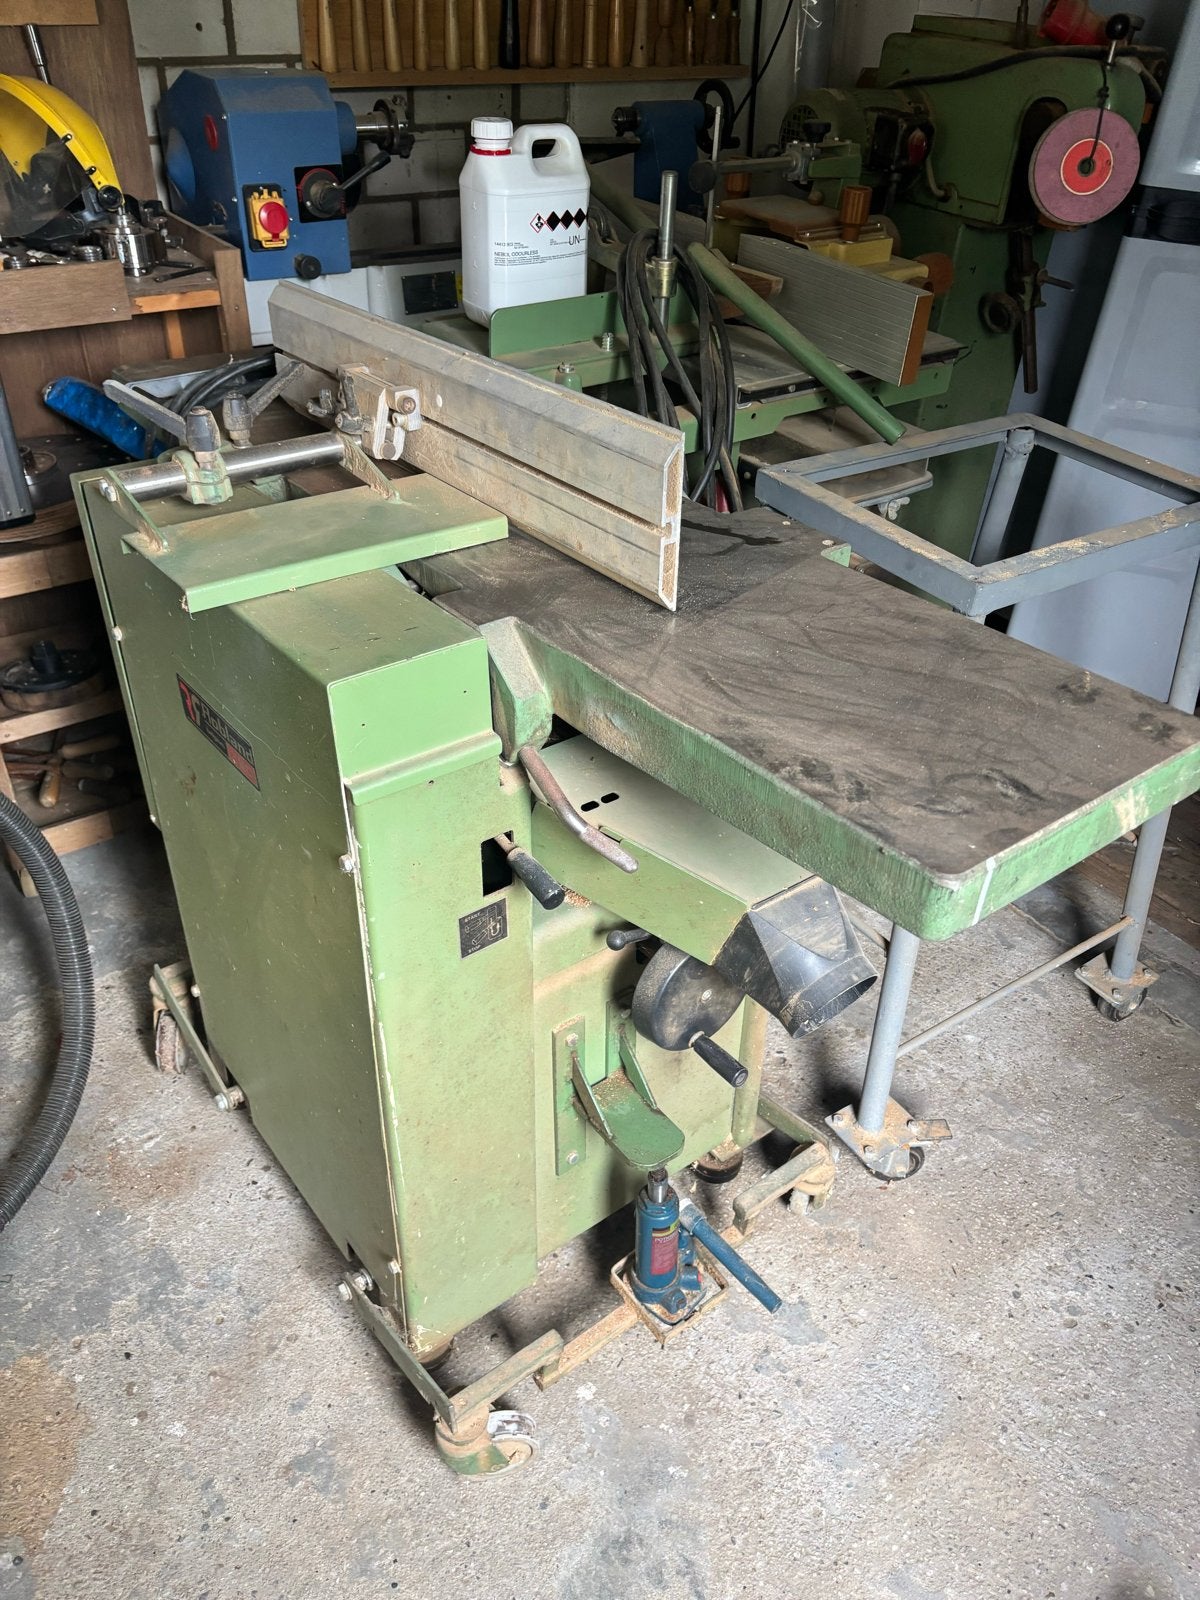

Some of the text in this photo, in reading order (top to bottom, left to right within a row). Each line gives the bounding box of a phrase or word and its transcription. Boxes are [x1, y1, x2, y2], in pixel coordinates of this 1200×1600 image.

[511, 249, 539, 257] ODOURLESS
[201, 703, 255, 767] Robland
[464, 912, 481, 922] START
